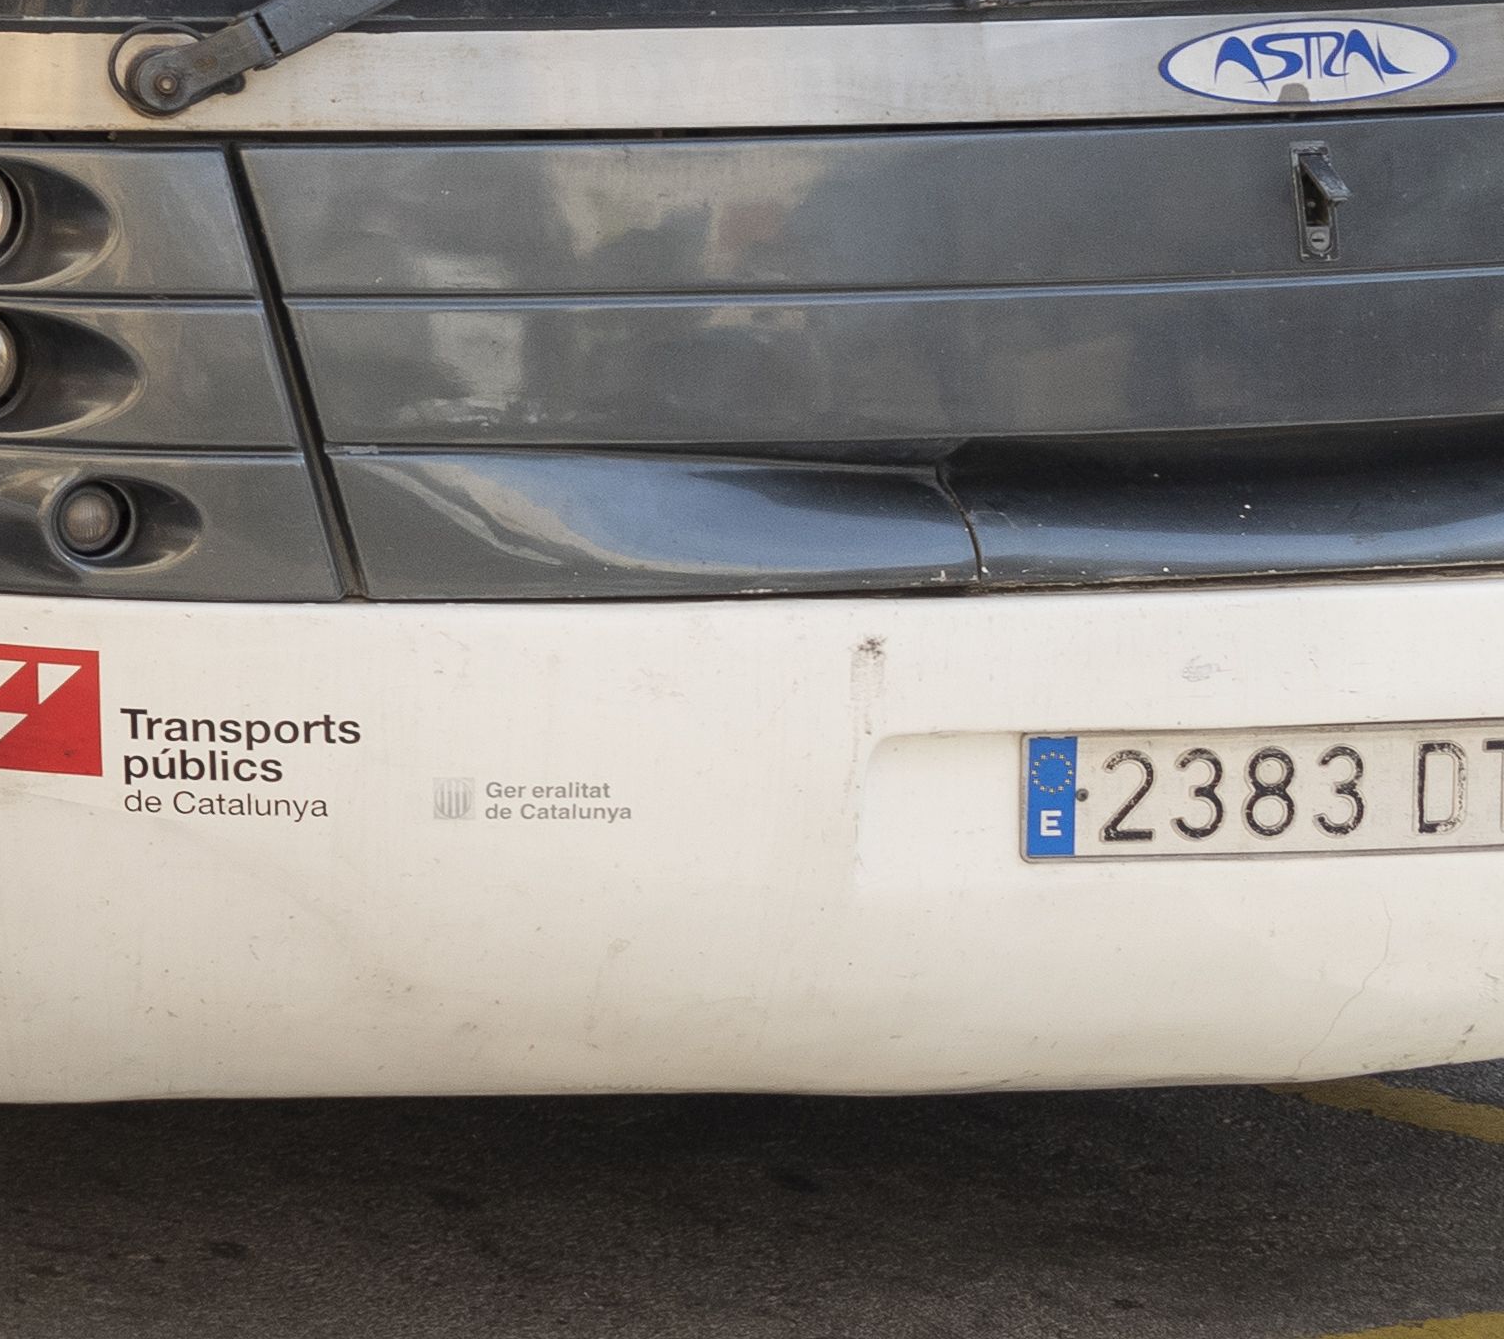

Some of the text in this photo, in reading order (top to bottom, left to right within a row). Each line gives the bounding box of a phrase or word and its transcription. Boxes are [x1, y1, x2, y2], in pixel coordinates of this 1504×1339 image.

[1213, 28, 1417, 93] ASTRAL
[120, 706, 362, 752] Transports
[122, 746, 284, 787] públics
[123, 787, 329, 824] de Catalunya
[485, 803, 632, 824] de Catalunya
[1100, 743, 1368, 843] 2383
[1039, 809, 1062, 837] E
